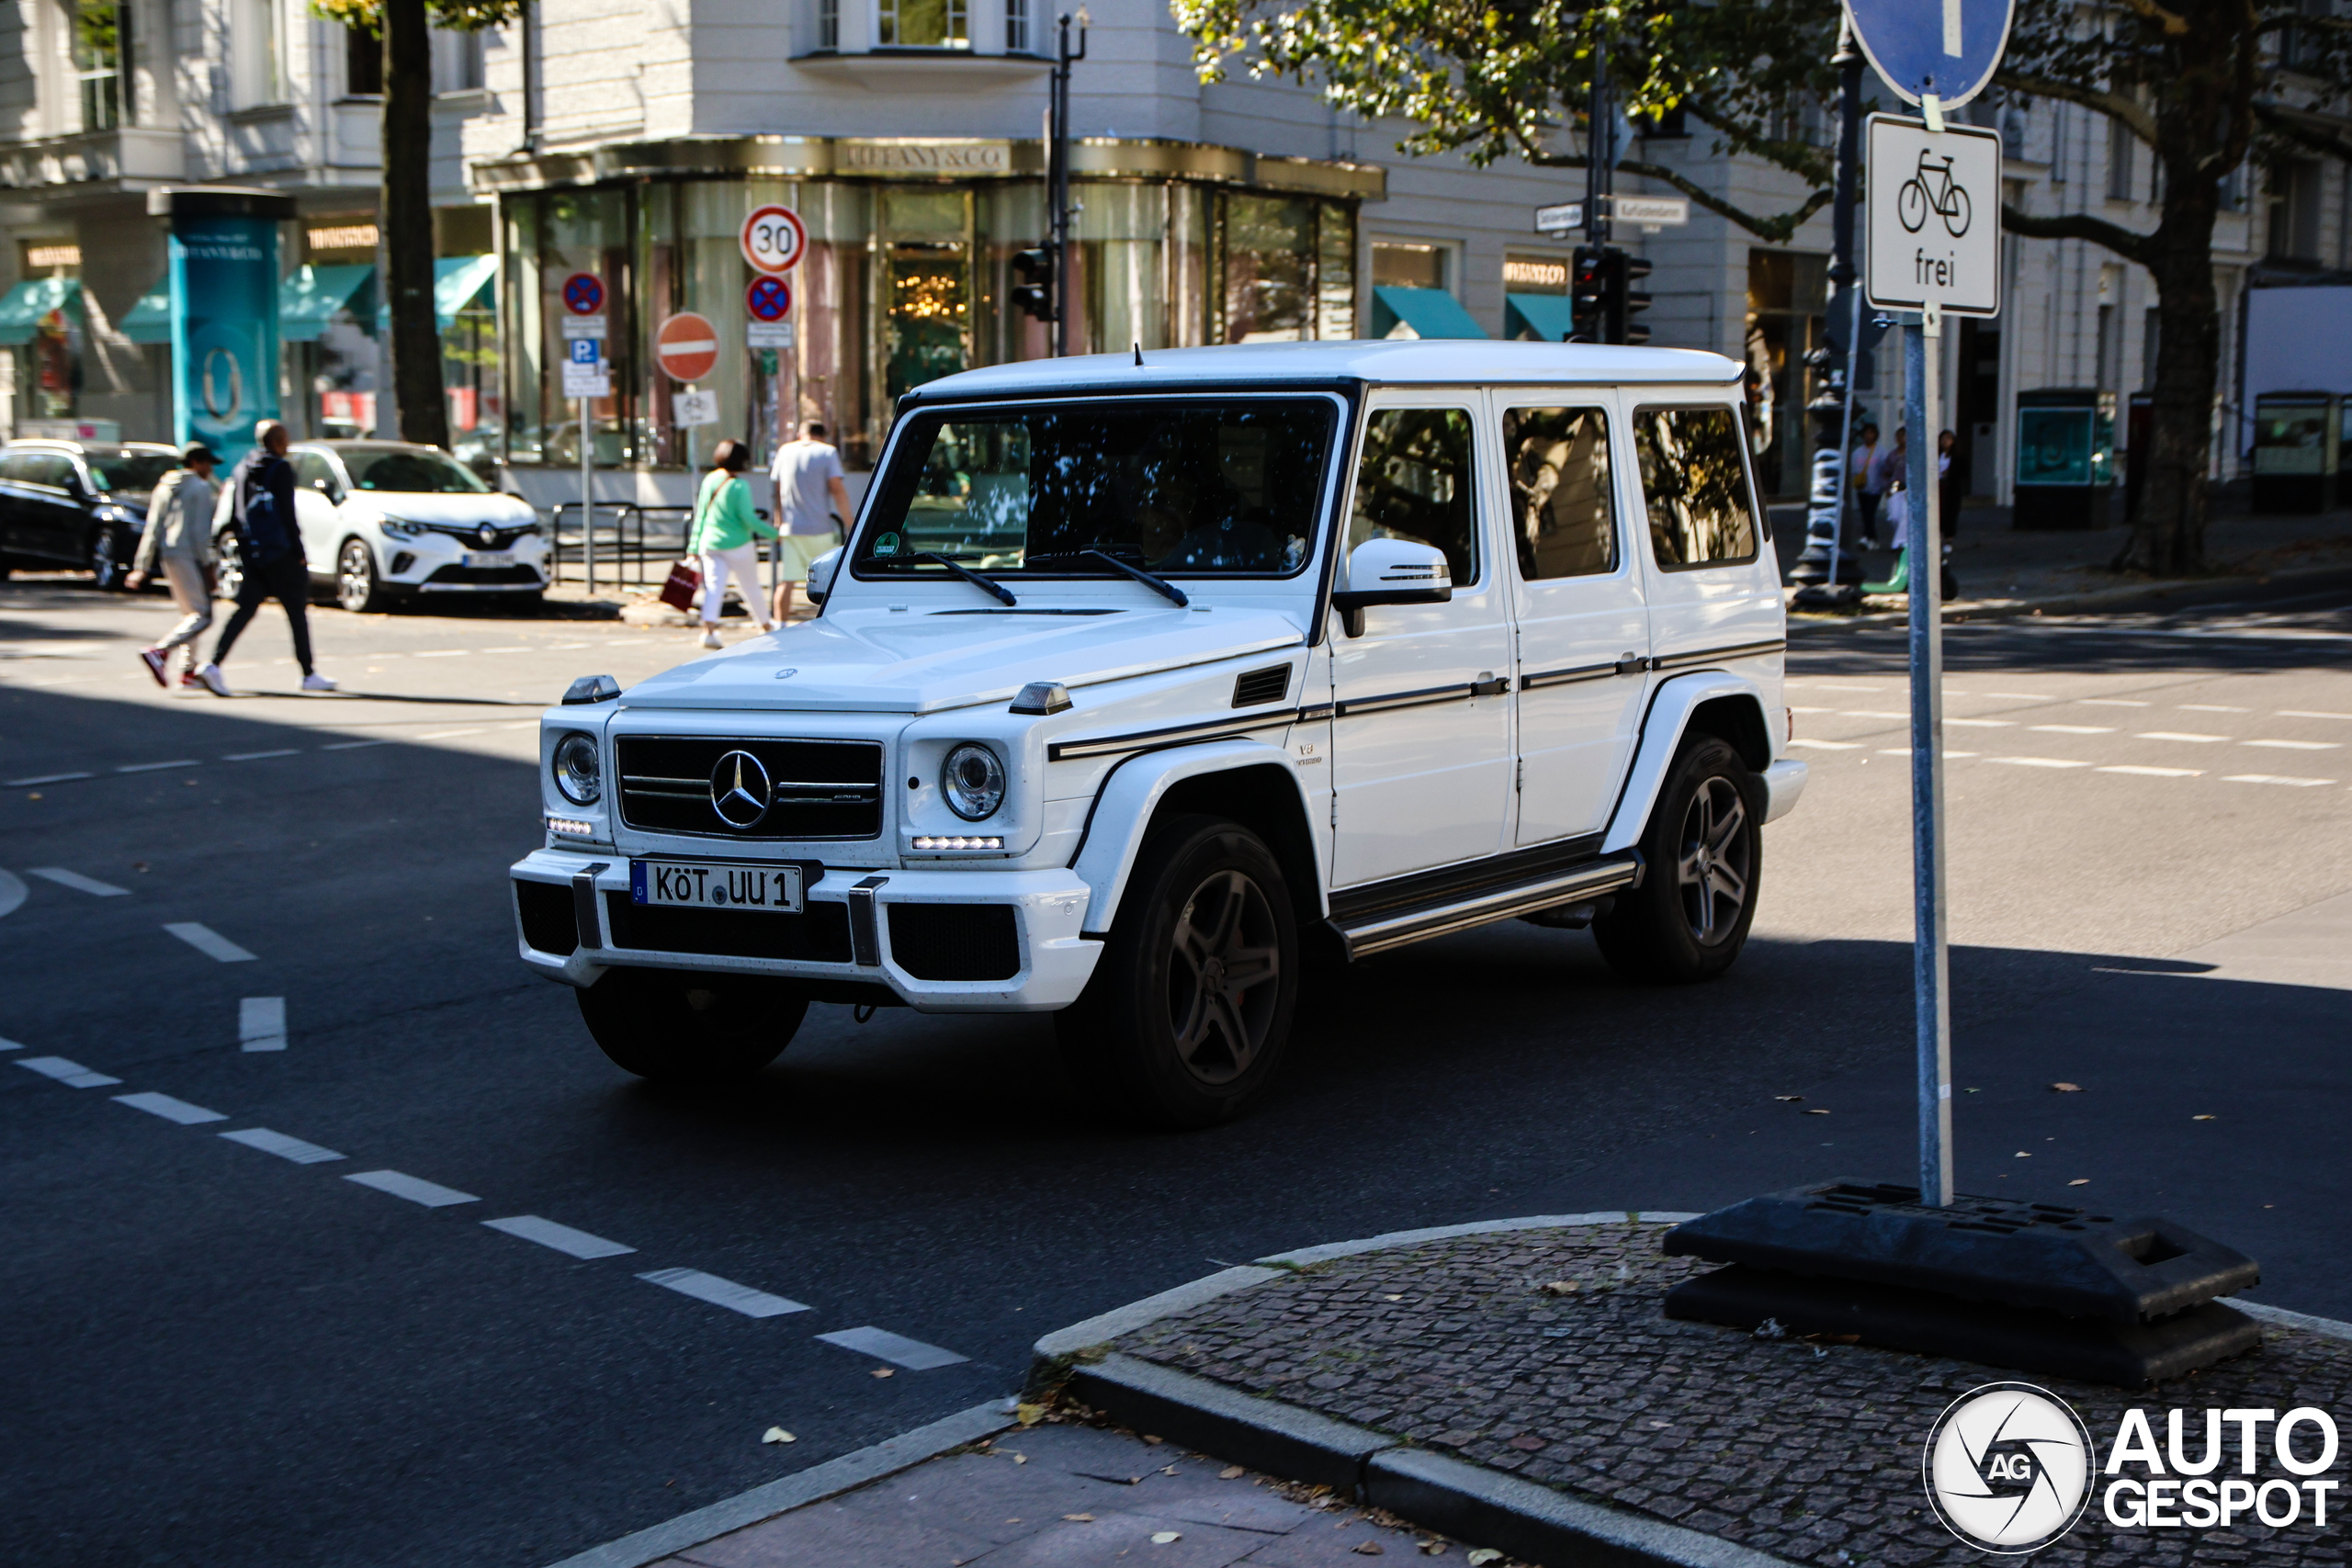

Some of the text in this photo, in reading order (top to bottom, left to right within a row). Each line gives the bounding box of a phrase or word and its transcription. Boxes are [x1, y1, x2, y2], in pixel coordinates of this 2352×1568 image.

[757, 224, 792, 254] 30
[1916, 246, 1954, 288] frei
[574, 340, 592, 362] P
[884, 534, 892, 546] 4
[637, 886, 643, 897] D
[656, 866, 709, 902] KÖT
